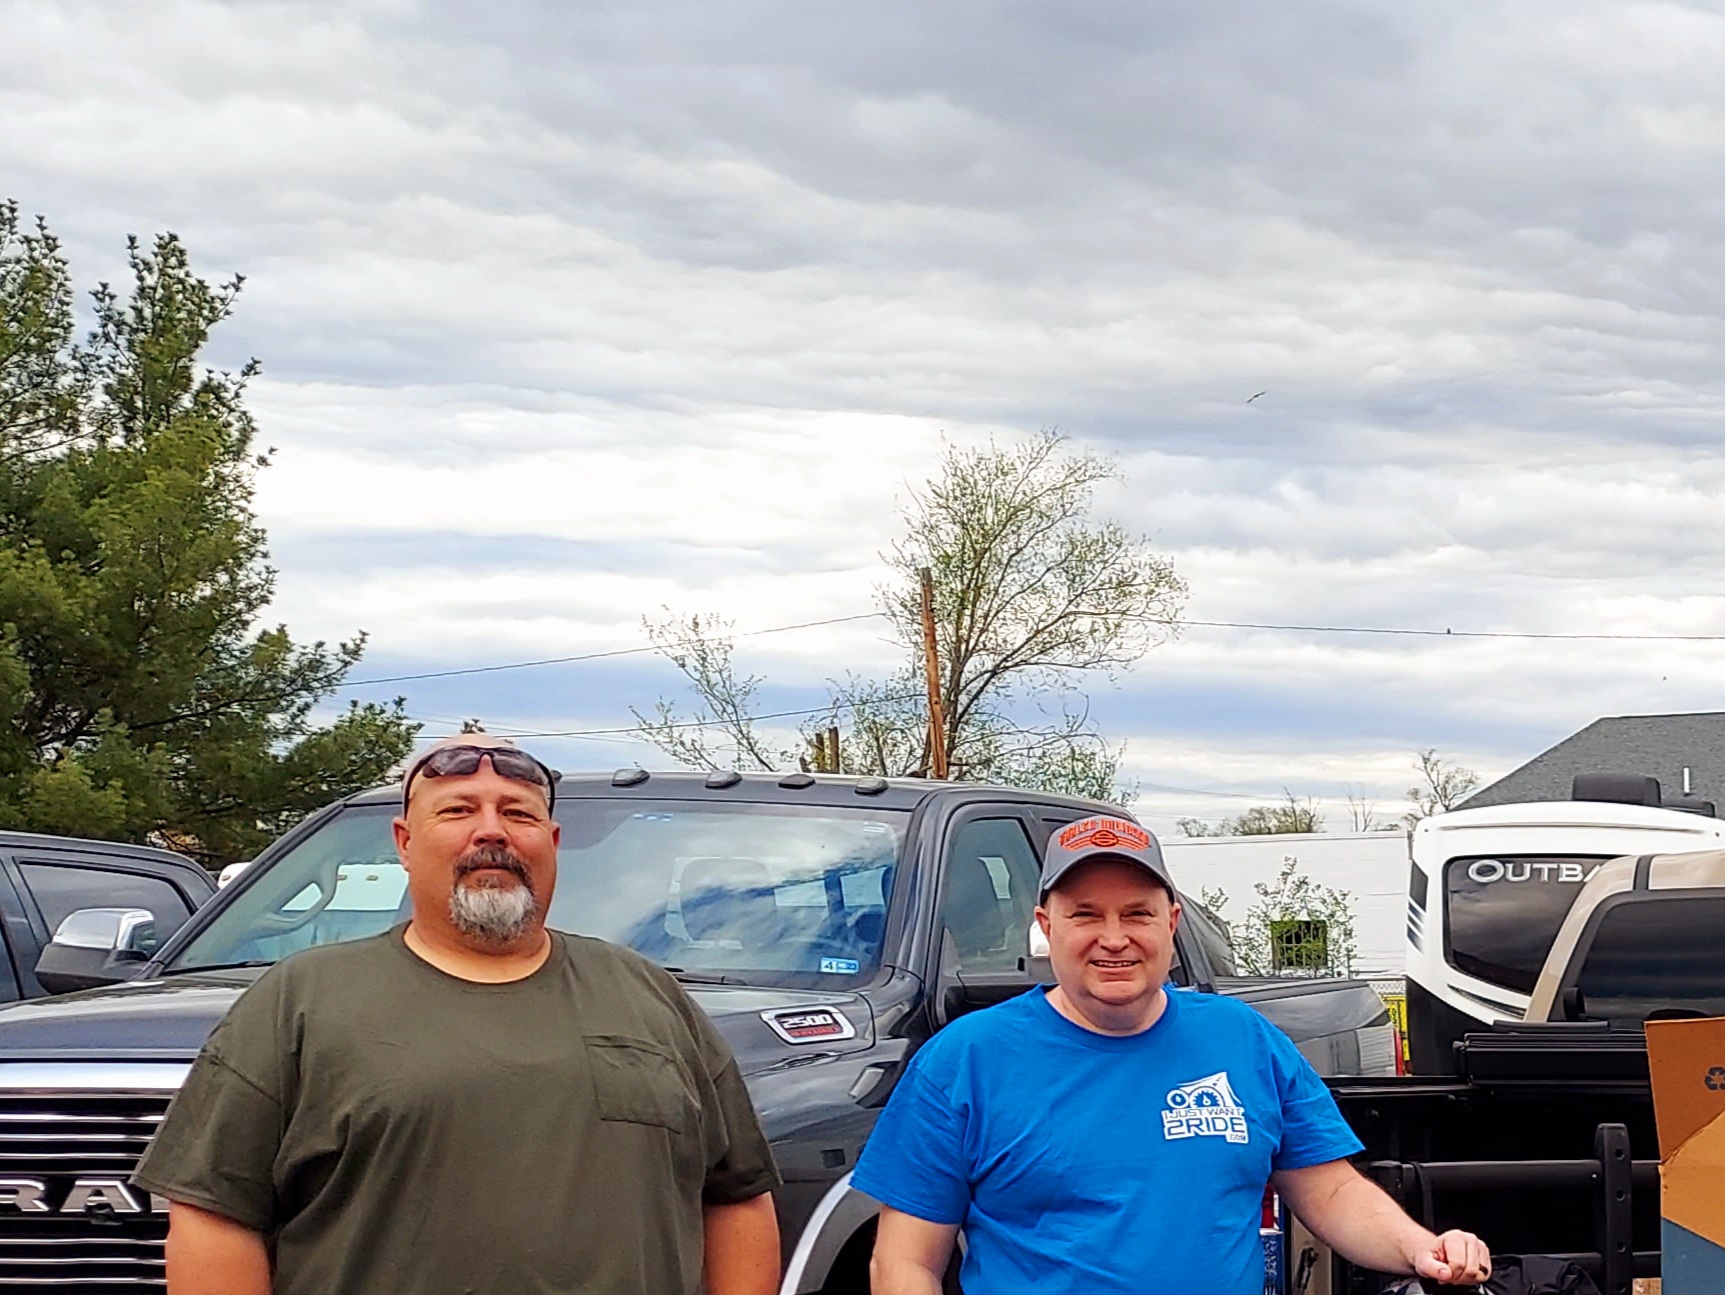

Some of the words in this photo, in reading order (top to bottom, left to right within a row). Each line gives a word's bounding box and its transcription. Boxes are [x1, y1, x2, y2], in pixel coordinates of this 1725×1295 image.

[780, 1014, 834, 1029] 2500
[1169, 1108, 1203, 1119] JUST
[1206, 1108, 1241, 1116] WANT
[1166, 1116, 1246, 1136] 2RIDE
[0, 1179, 171, 1213] RA
